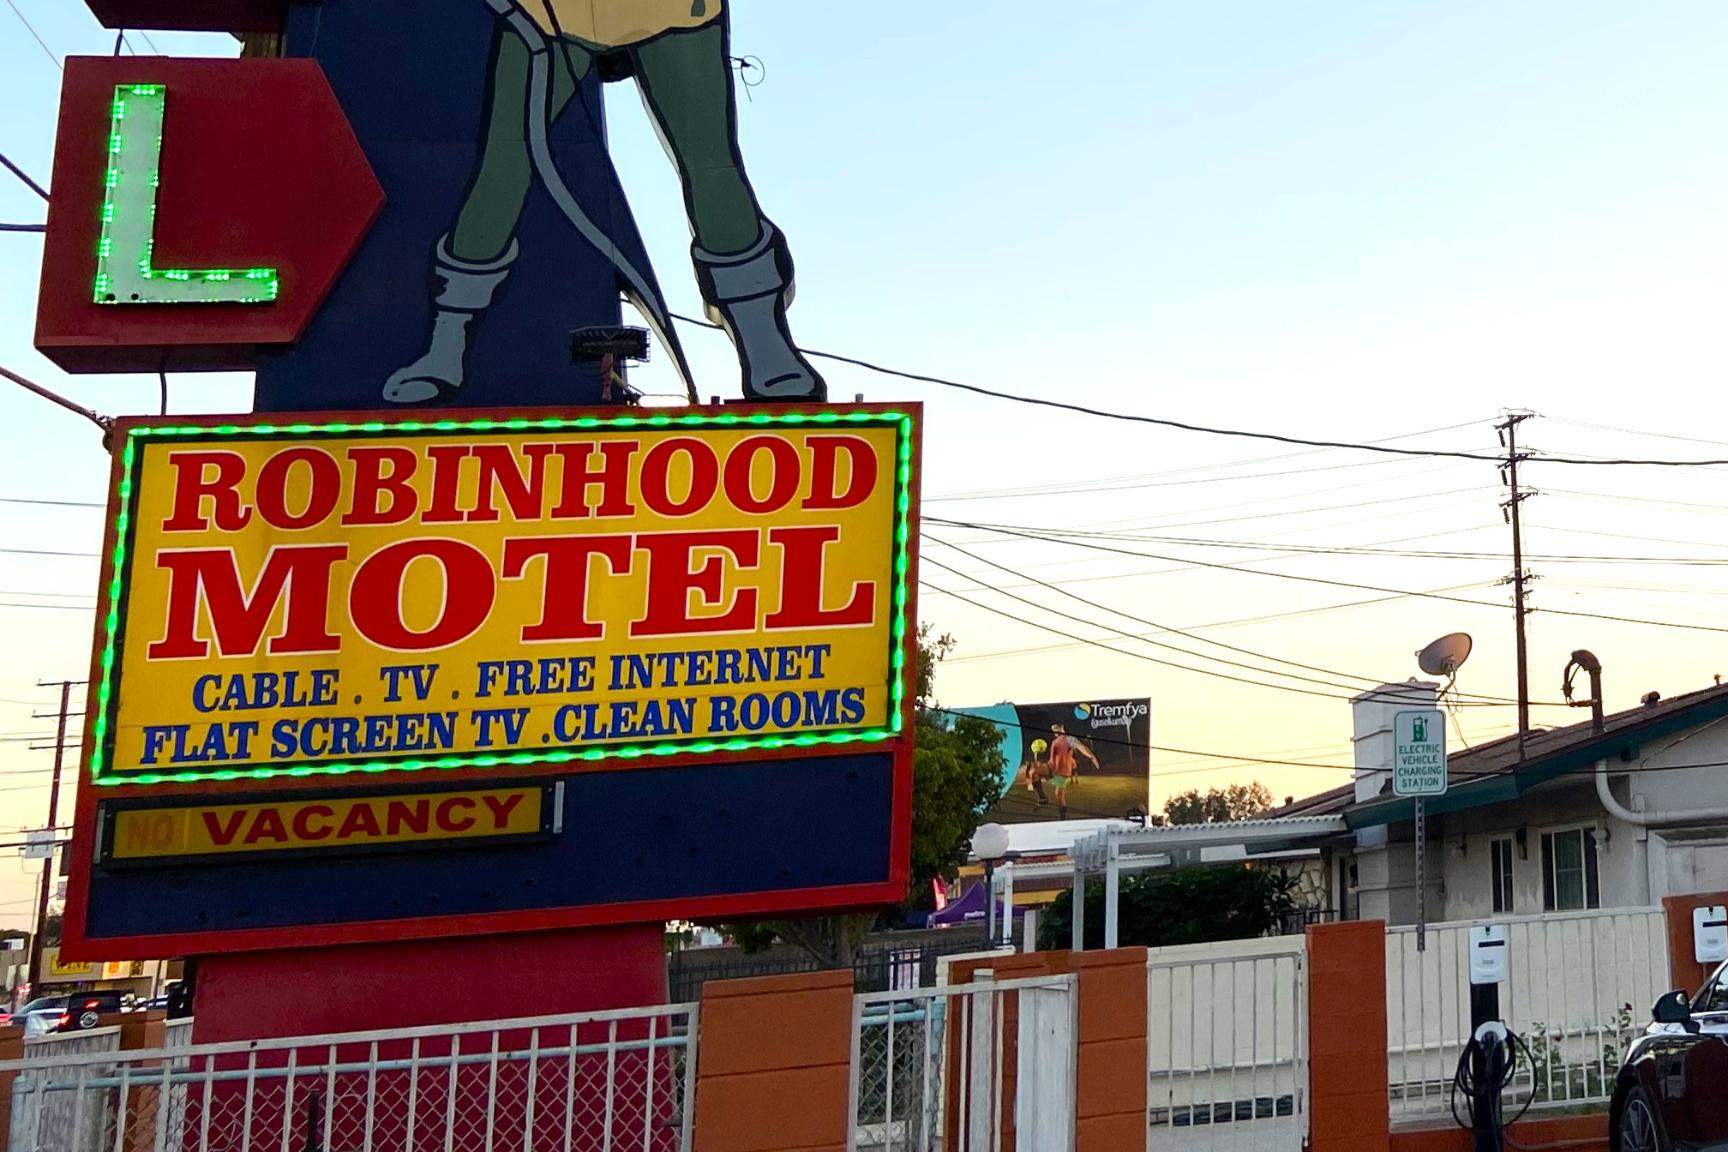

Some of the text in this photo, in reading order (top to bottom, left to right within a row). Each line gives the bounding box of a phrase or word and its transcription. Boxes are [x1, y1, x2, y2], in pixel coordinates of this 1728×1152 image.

[161, 435, 878, 533] ROBINHOOD
[146, 524, 877, 661] MOTEL
[192, 669, 340, 712] CABLE
[380, 663, 440, 703] TV
[475, 656, 596, 698] FREE
[608, 644, 831, 690] INTERNET
[140, 721, 259, 765] FLAT
[270, 710, 459, 758] SCREEN
[471, 708, 530, 747] TV
[708, 687, 866, 732] ROOMS
[1091, 702, 1147, 718] Tremfya
[1399, 744, 1440, 754] ELECTRIC
[1402, 755, 1439, 765] VEHICLE
[1398, 766, 1442, 776] CHARGING
[1402, 778, 1439, 788] STATION
[127, 794, 525, 848] NO VACANCY
